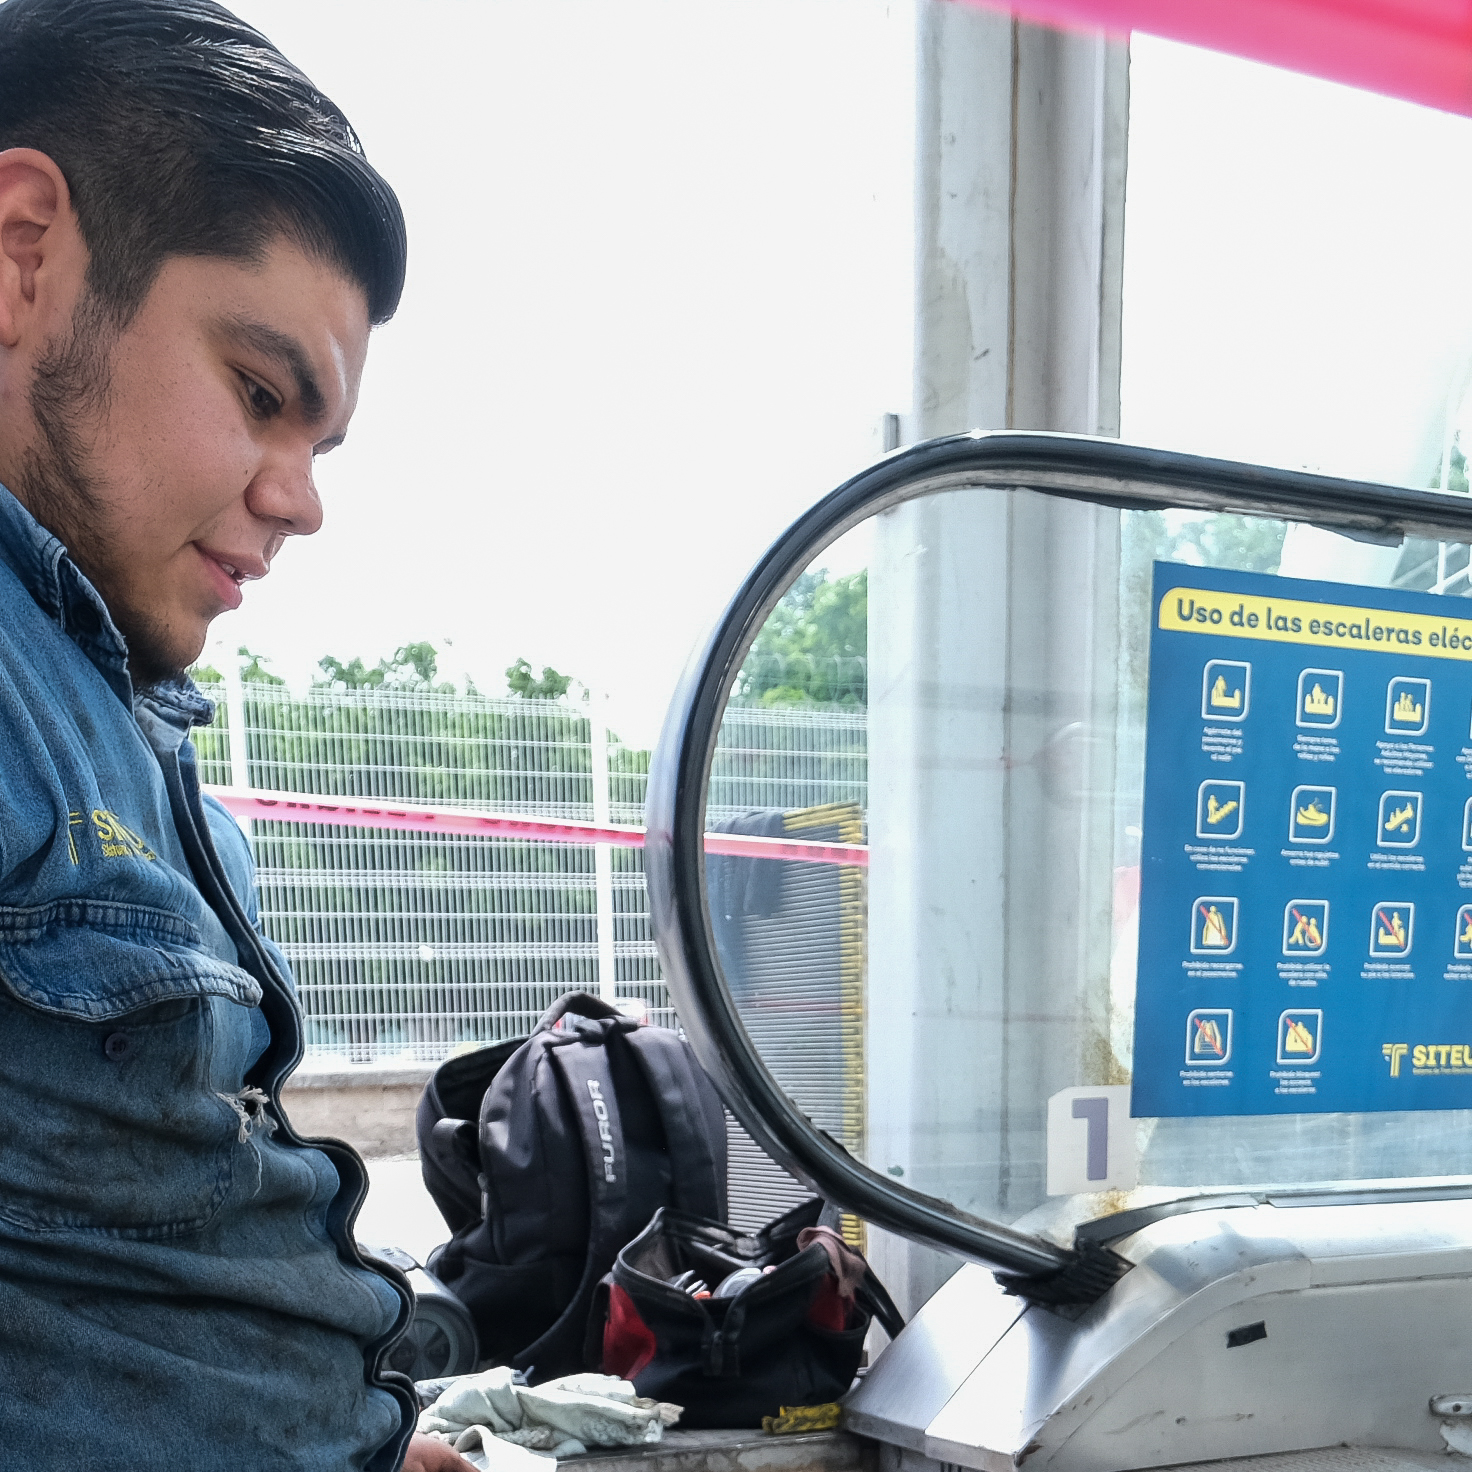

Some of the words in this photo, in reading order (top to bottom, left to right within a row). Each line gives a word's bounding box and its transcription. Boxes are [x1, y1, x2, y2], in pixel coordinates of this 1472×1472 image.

[1176, 598, 1223, 625] Uso
[1229, 603, 1260, 629] de
[1266, 606, 1302, 633] las
[1308, 617, 1423, 646] escaleras
[586, 1079, 616, 1183] FUROR
[1071, 1097, 1109, 1181] 1
